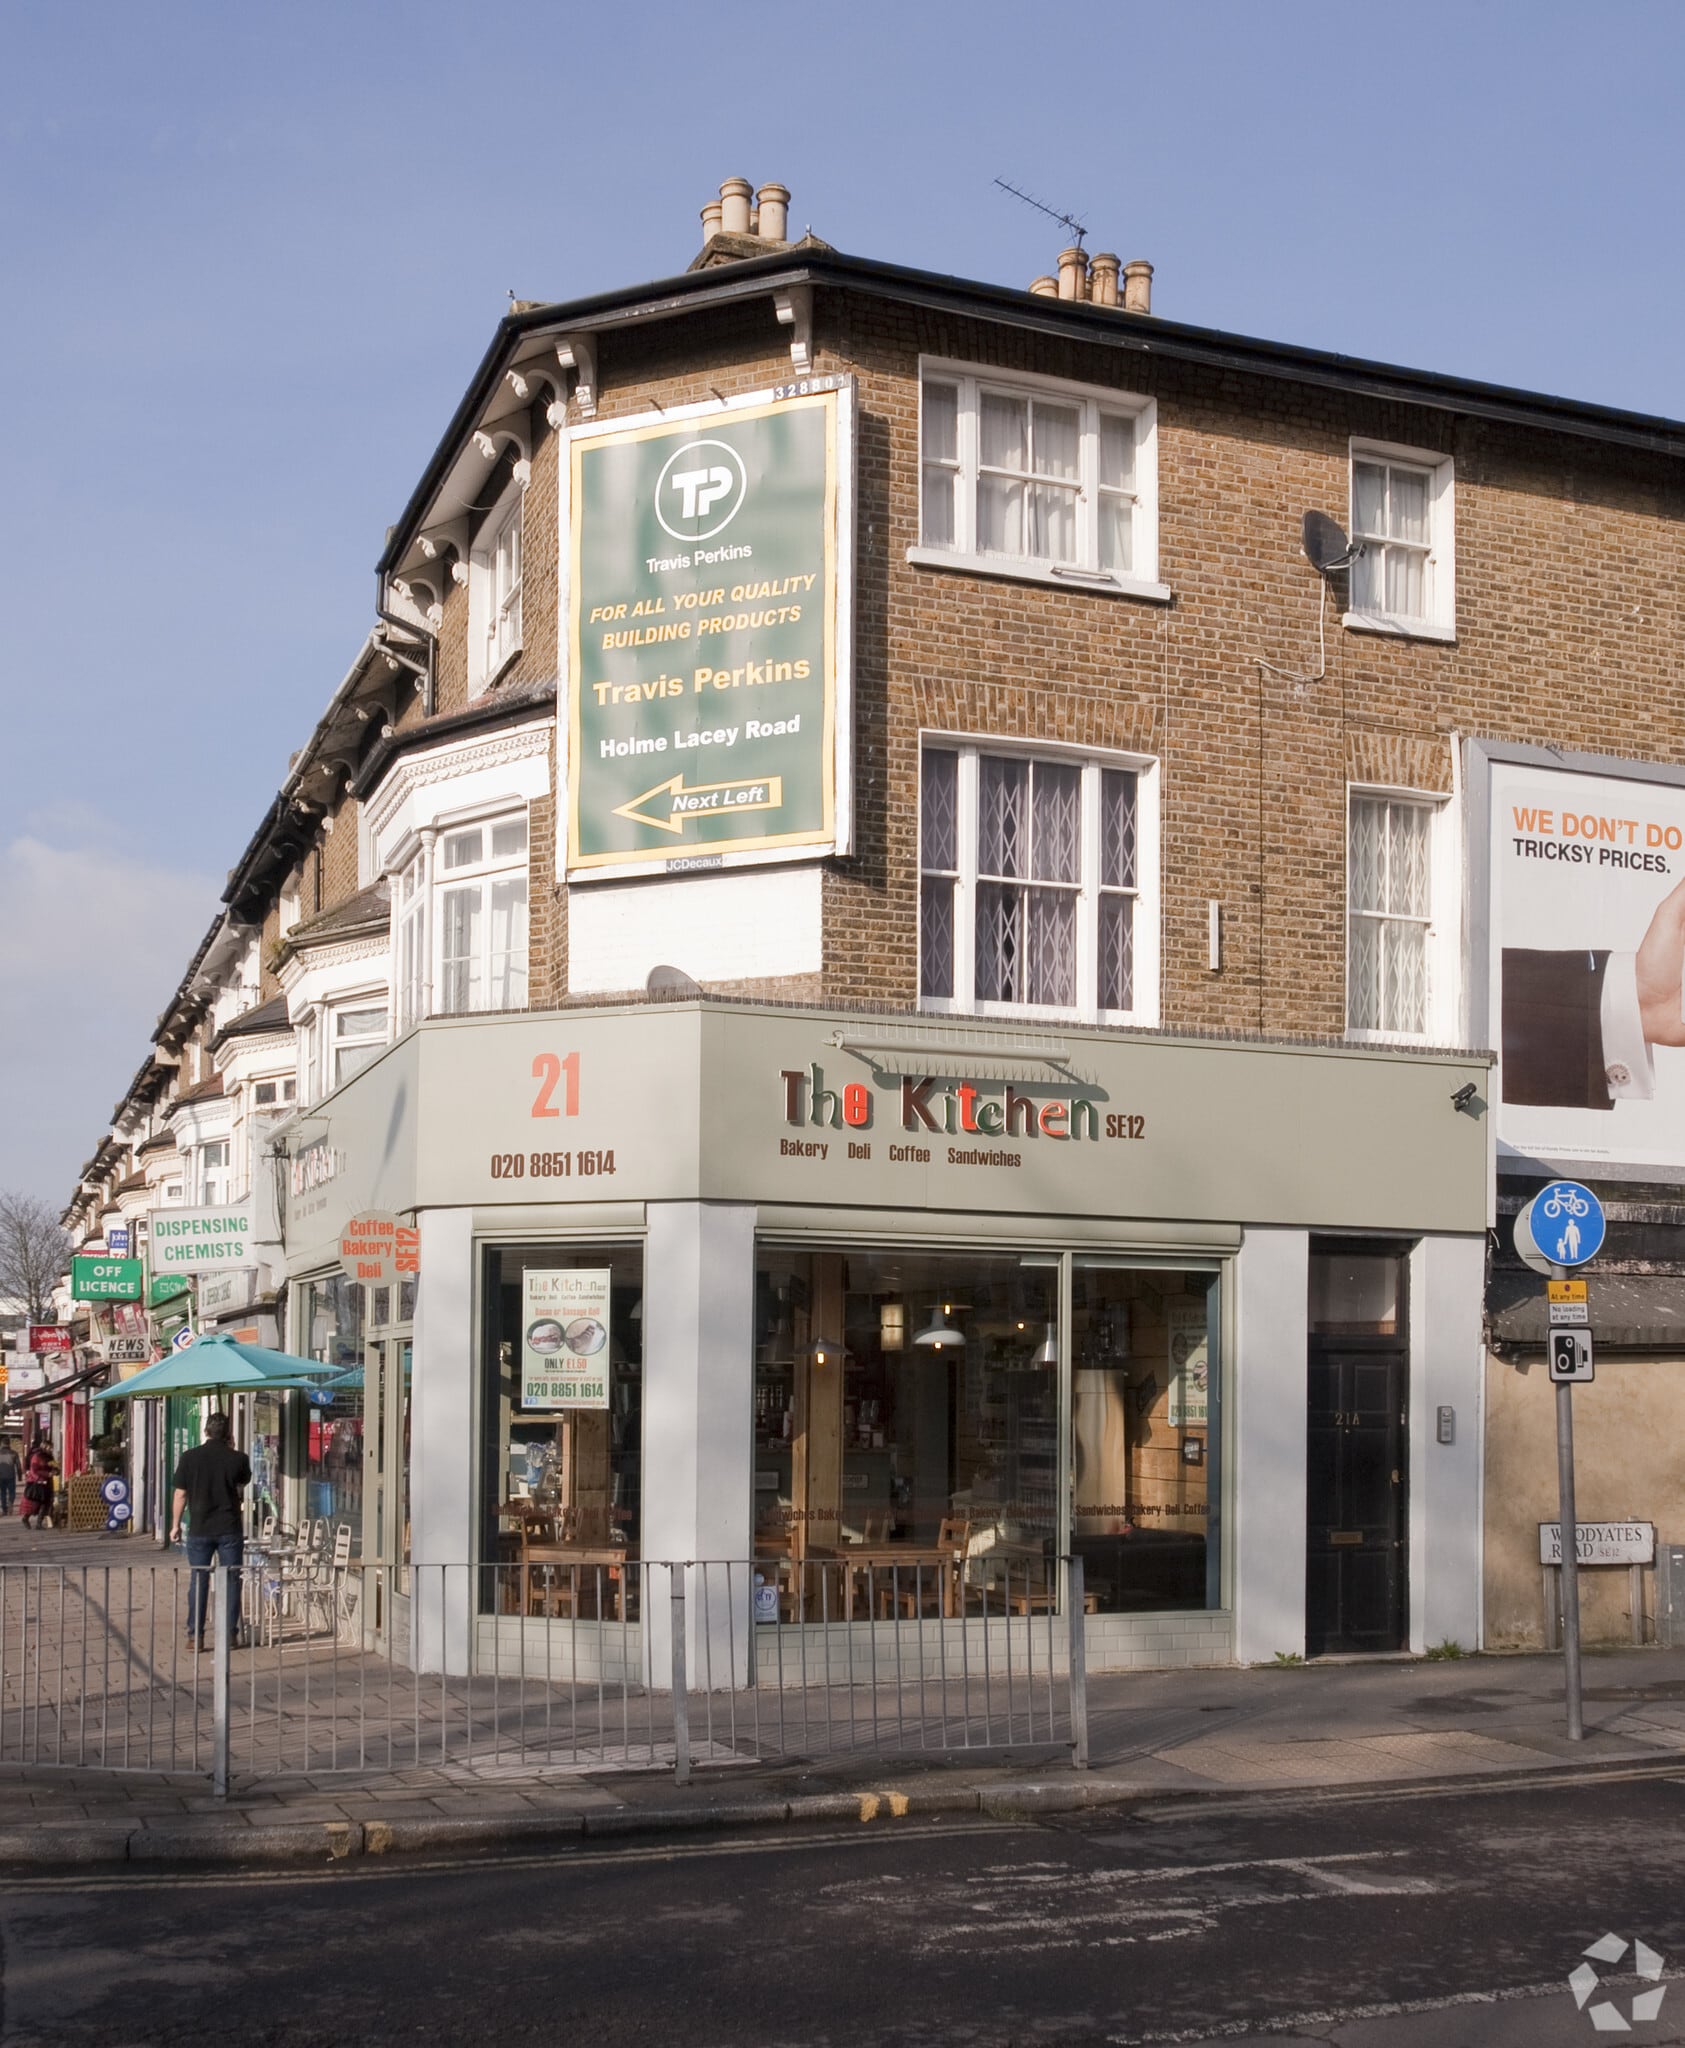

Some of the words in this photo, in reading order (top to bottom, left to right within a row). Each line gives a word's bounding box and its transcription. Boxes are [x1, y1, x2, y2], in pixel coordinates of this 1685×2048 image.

[672, 464, 734, 519] TP
[646, 553, 691, 574] Travis
[694, 544, 753, 566] Perkins
[589, 603, 627, 624] FOR
[631, 597, 666, 618] ALL
[672, 588, 725, 611] YOUR
[730, 573, 817, 603] QUALITY
[602, 621, 692, 650] BUILDING
[697, 605, 802, 636] PRODUCTS
[592, 674, 684, 706] Travis
[694, 658, 811, 693] Perkins
[600, 735, 668, 758] Holme
[674, 726, 739, 749] Lacey
[745, 714, 801, 740] Road
[672, 790, 719, 811] Next
[722, 786, 764, 806] Left
[1512, 806, 1554, 834] WE
[1561, 812, 1639, 845] DON'T
[1646, 823, 1683, 850] DO
[667, 857, 722, 871] JCDecaux
[1512, 838, 1594, 864] TRICKSY
[1599, 848, 1671, 874] PRICES.
[531, 1051, 580, 1118] 21
[779, 1062, 869, 1126] The
[900, 1074, 1096, 1138] Kitchen
[1105, 1113, 1145, 1140] SE12
[780, 1138, 829, 1160] Bakery
[848, 1141, 871, 1160] Deli
[889, 1144, 931, 1163] Coffee
[947, 1147, 1021, 1167] Sandwiches
[491, 1153, 525, 1179] 020
[530, 1152, 571, 1178] 8851
[577, 1150, 616, 1176] 1614
[155, 1217, 249, 1237] DISPENSING
[350, 1219, 394, 1236] Coffee
[164, 1241, 244, 1260] CHEMISTS
[342, 1239, 392, 1257] Bakery
[395, 1227, 421, 1272] SE12
[93, 1265, 122, 1277] OFF
[357, 1262, 382, 1278] Deli
[79, 1280, 135, 1293] LICENCE
[108, 1339, 145, 1351] NEWS
[544, 1358, 565, 1369] ONLY
[527, 1382, 548, 1397] 020
[551, 1382, 577, 1398] 8851
[580, 1383, 605, 1398] 1614
[1335, 1412, 1360, 1425] 21A
[1076, 1504, 1127, 1517] Sandwiches
[1551, 1527, 1642, 1542] WODYATES
[1552, 1543, 1594, 1558] RAD
